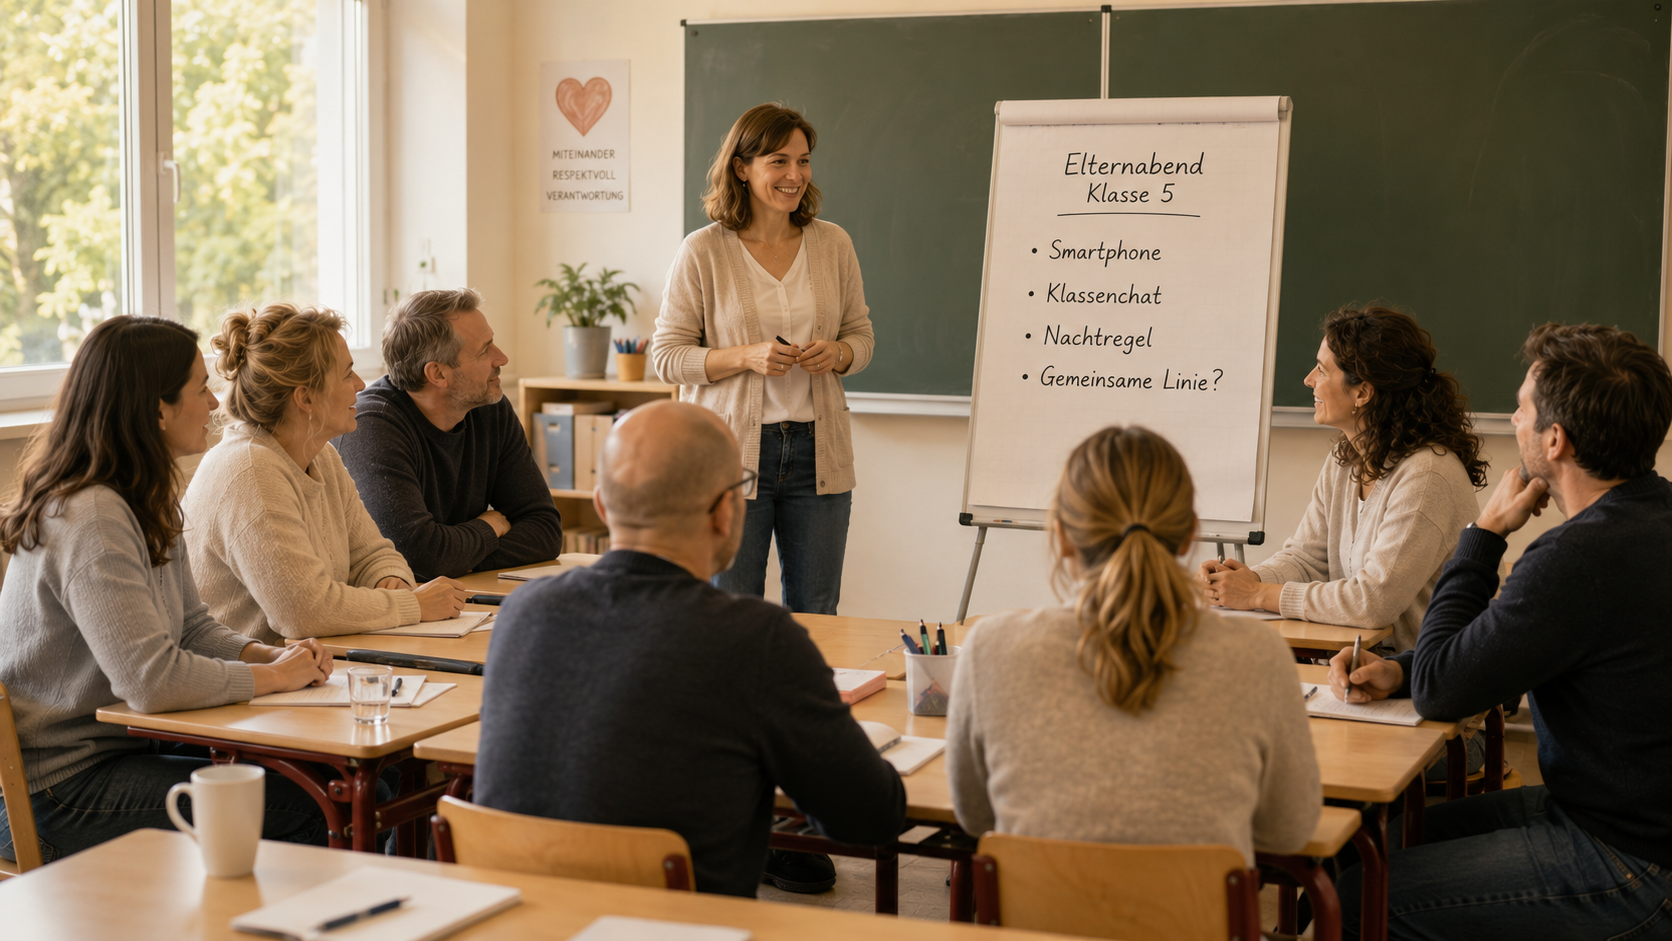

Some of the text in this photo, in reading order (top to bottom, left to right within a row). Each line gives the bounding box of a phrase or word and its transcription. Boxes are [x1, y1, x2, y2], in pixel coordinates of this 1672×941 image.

[552, 149, 616, 160] MITEINANDER
[1065, 152, 1204, 175] Elternabend
[552, 170, 616, 180] RESPEKTVOLL
[546, 191, 624, 201] VERANTWORTUNG
[1087, 182, 1176, 203] Klasse 5
[1049, 239, 1162, 267] Smartphone
[1046, 282, 1162, 304] Klassenchat
[1044, 324, 1153, 354] Nachtregel
[1040, 365, 1224, 391] Gemeinsame Linie?
